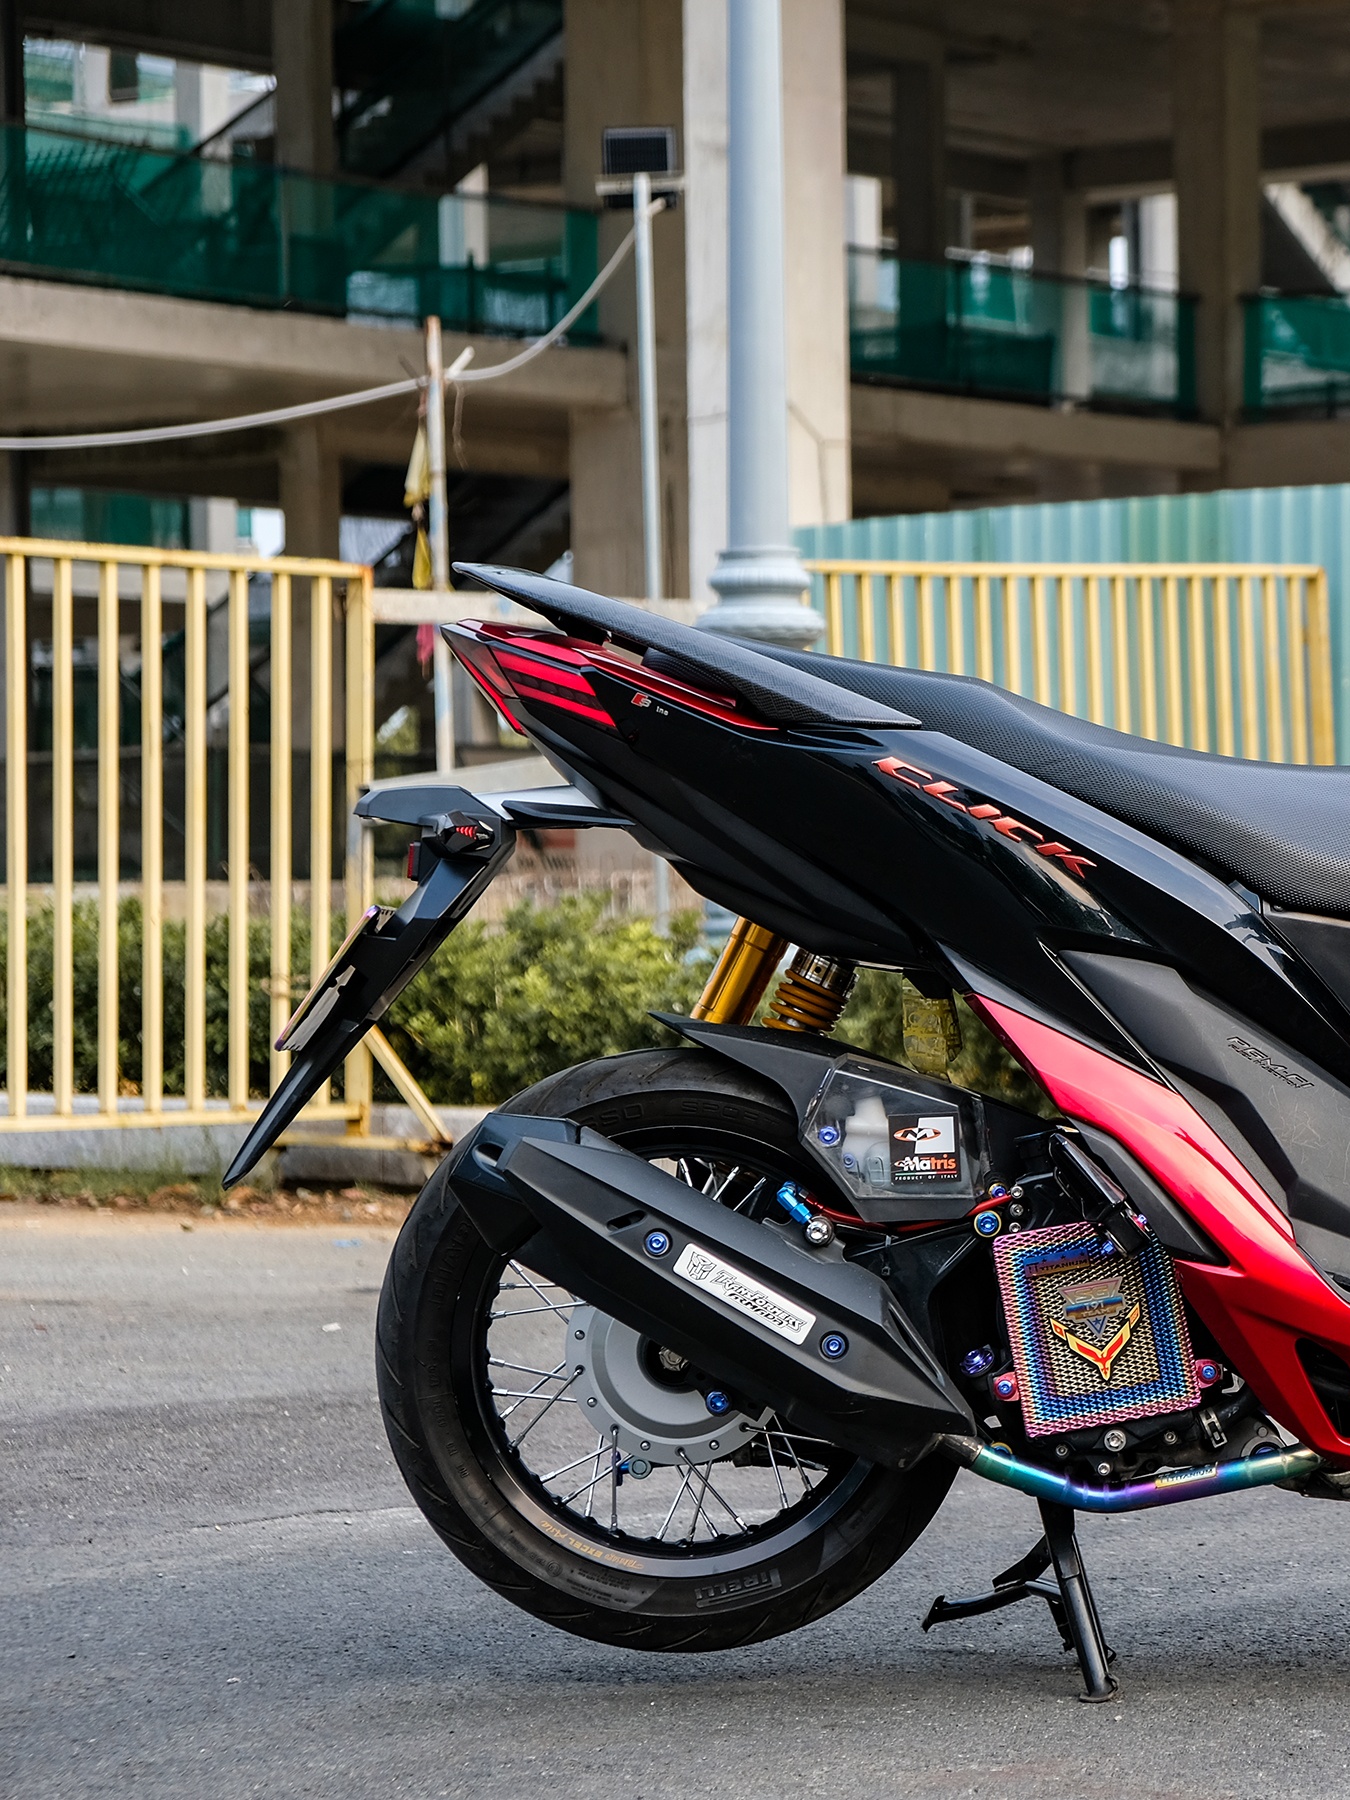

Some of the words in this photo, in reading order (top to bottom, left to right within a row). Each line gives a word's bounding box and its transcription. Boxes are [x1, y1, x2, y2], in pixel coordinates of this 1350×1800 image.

[871, 756, 1098, 879] CLICK
[903, 1154, 957, 1171] Matris
[1039, 1259, 1089, 1272] TITANIUM
[710, 1269, 808, 1334] TRANSFORMERS
[568, 1537, 604, 1559] EXCEL
[694, 1567, 783, 1608] PIRELLI
